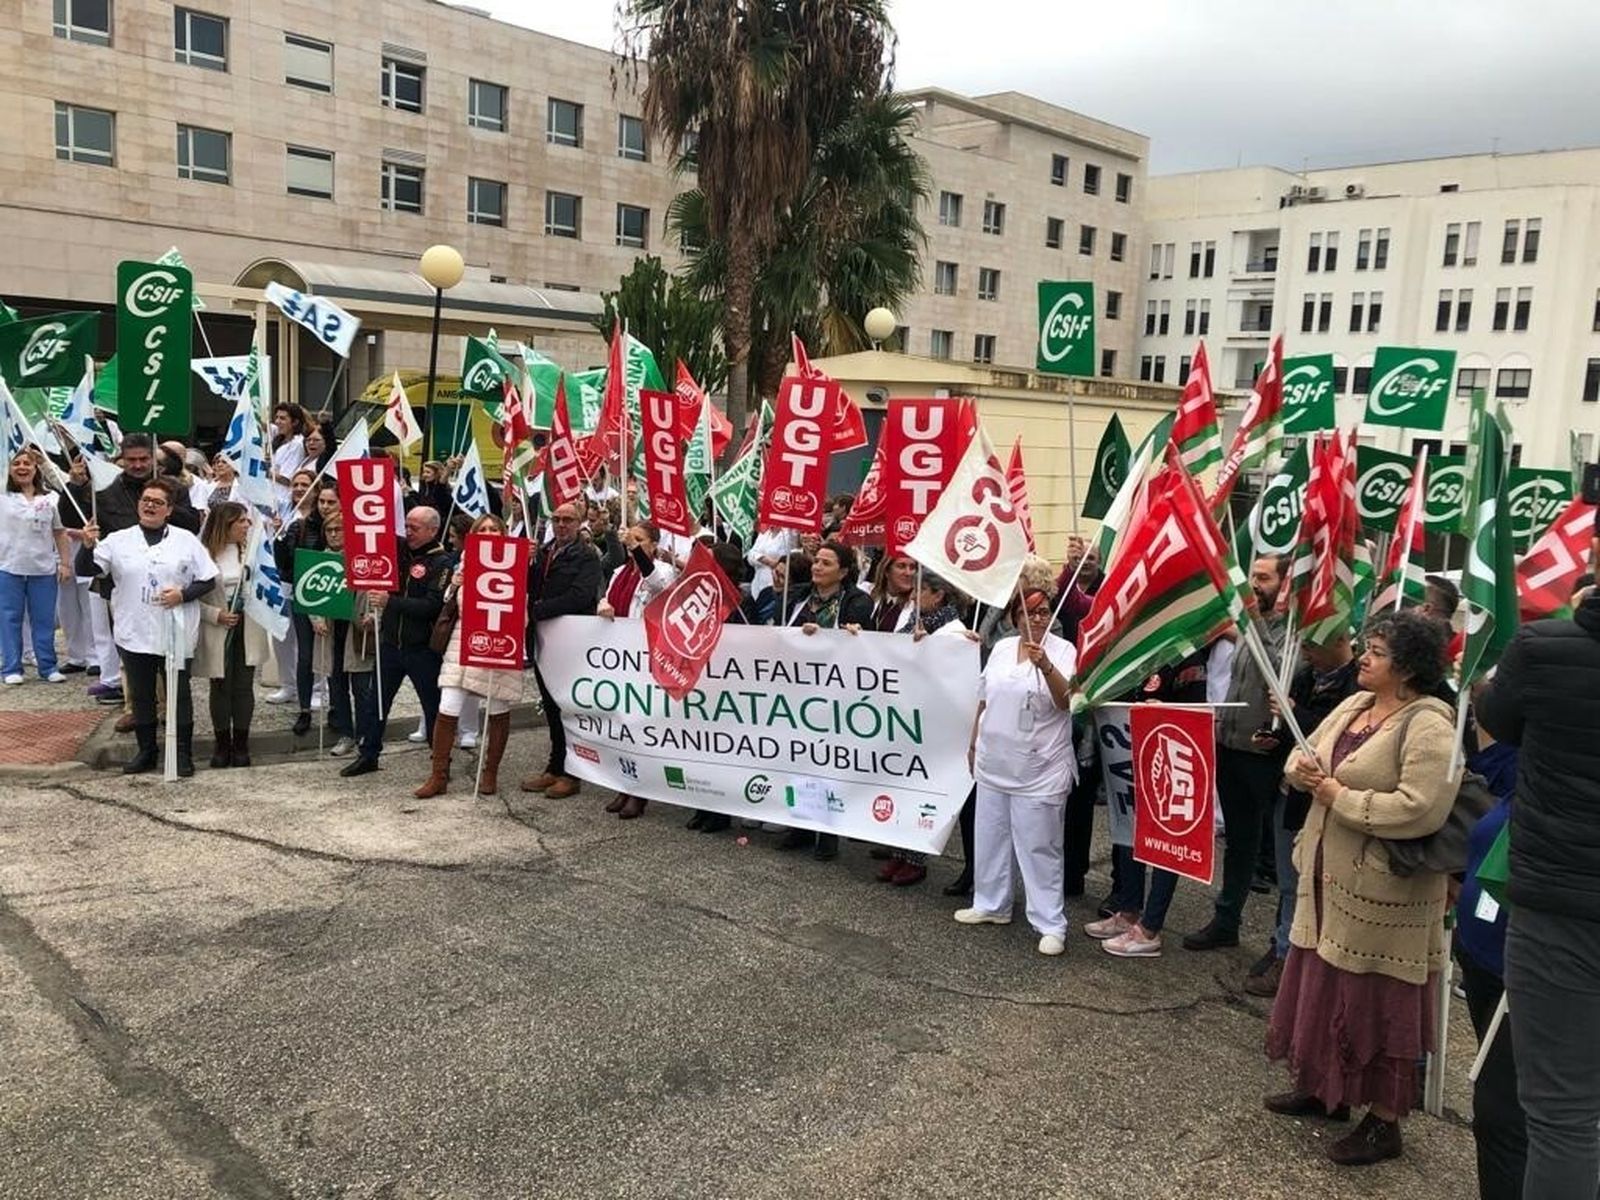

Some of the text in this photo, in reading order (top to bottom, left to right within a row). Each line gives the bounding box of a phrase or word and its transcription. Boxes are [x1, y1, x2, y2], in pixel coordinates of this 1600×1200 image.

[142, 324, 167, 427] CSIF
[650, 397, 678, 496] UGT
[782, 384, 826, 488] UGT
[899, 406, 944, 515] UGT
[350, 464, 386, 554] UGT
[476, 540, 517, 632] UGT
[571, 677, 923, 745] CONTRATACIÓN
[707, 657, 744, 681] LA
[754, 659, 846, 689] FALTA
[856, 666, 900, 695] DE
[574, 714, 930, 780] EN LA SANIDAD PÚBLICA
[1168, 739, 1195, 822] UGT
[1144, 836, 1203, 863] www.ugt.es
